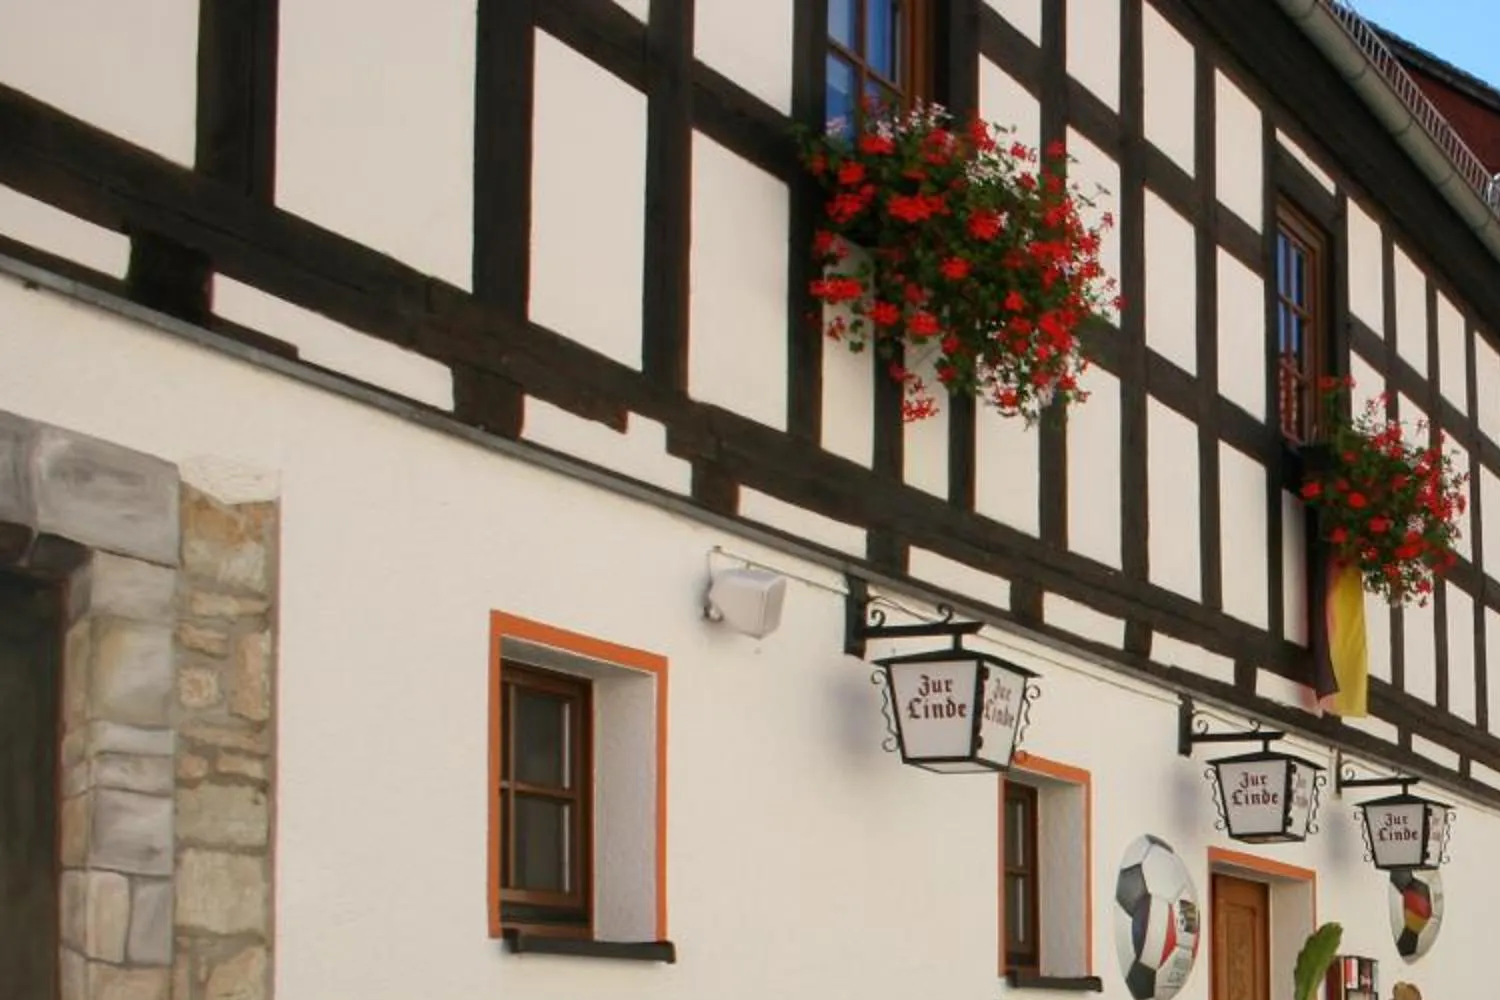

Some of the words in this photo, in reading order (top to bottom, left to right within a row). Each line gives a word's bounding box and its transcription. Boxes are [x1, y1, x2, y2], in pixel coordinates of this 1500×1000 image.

[918, 674, 954, 697] Zur
[907, 697, 967, 719] Linde
[1239, 771, 1268, 789] Zur
[1232, 789, 1279, 805] Linde
[1384, 813, 1409, 827] Zur
[1379, 827, 1418, 841] Linde
